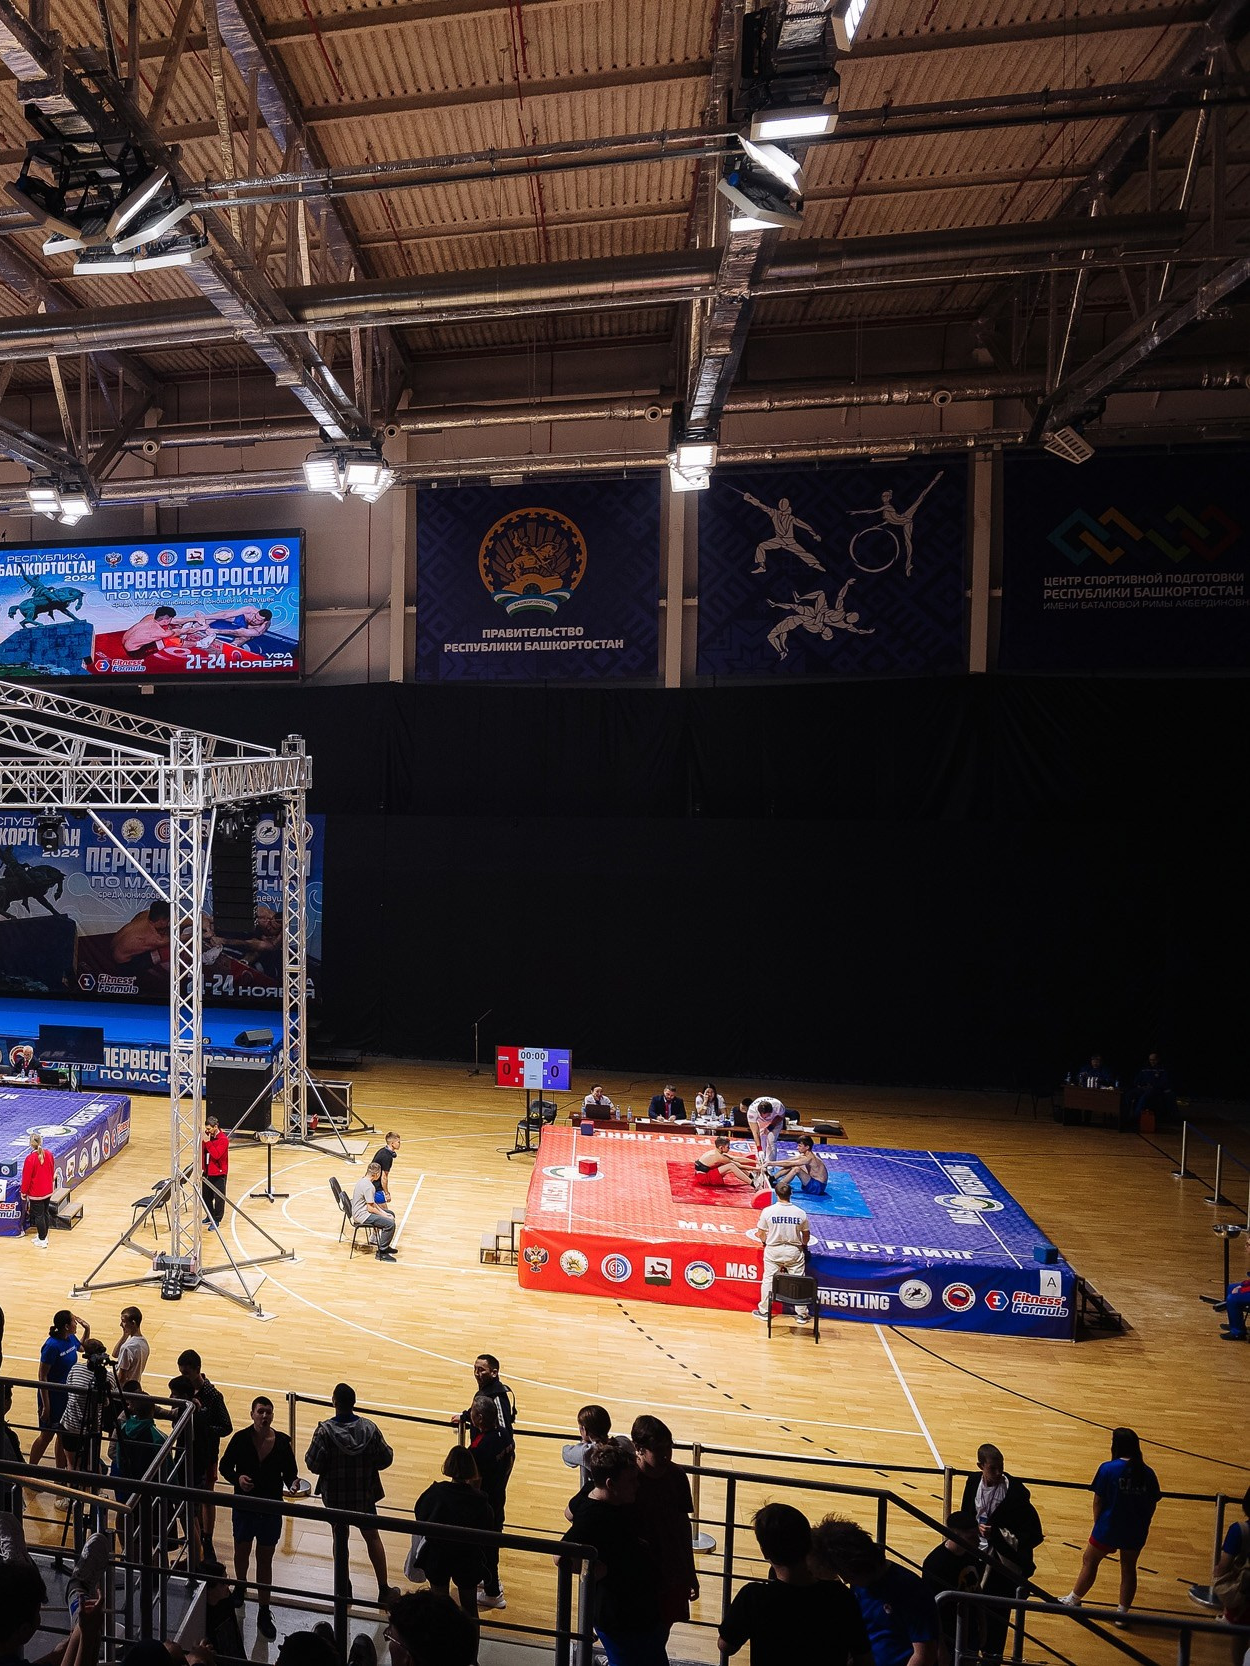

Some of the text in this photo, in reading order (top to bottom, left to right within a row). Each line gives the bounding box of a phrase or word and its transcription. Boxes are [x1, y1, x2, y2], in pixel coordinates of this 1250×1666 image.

[7, 553, 86, 562] РЕСПУБЛИКА
[64, 574, 96, 582] 2024
[101, 566, 289, 590] ПЕРВЕНСТВО РОССИИ
[1044, 572, 1245, 587] ЦЕНТР СПОРТИВНОЙ ПОДГОТОВКИ
[106, 587, 285, 600] ПО МАС-РЕСТЛИНГУ
[1043, 586, 1244, 599] РЕСПУБЛИКИ БАШКОРТОСТАН
[1043, 602, 1079, 610] ИМЕНИ
[1081, 600, 1140, 609] БАТАЛОВОЙ
[482, 627, 584, 638] ПРАВИТЕЛЬСТВО
[444, 639, 624, 653] РЕСПУБЛИКИ БАШКОРТОСТАН
[186, 653, 294, 670] 21-24 НОЯБРЯ
[265, 652, 293, 660] УФА
[111, 664, 147, 673] Formula
[91, 876, 121, 888] ПО
[98, 892, 122, 900] среди
[98, 973, 134, 985] Fitness
[97, 982, 139, 994] Formula
[520, 1051, 546, 1061] 00:00
[100, 1069, 124, 1080] ПО
[502, 1063, 511, 1075] 0
[550, 1065, 560, 1078] 0
[771, 1216, 802, 1226] REFEREE
[825, 1240, 974, 1260] РЕСТЛИНГ
[725, 1262, 758, 1280] MAS
[817, 1290, 890, 1311] RESTLING
[1012, 1290, 1063, 1306] Fitness
[1012, 1302, 1069, 1318] Formula
